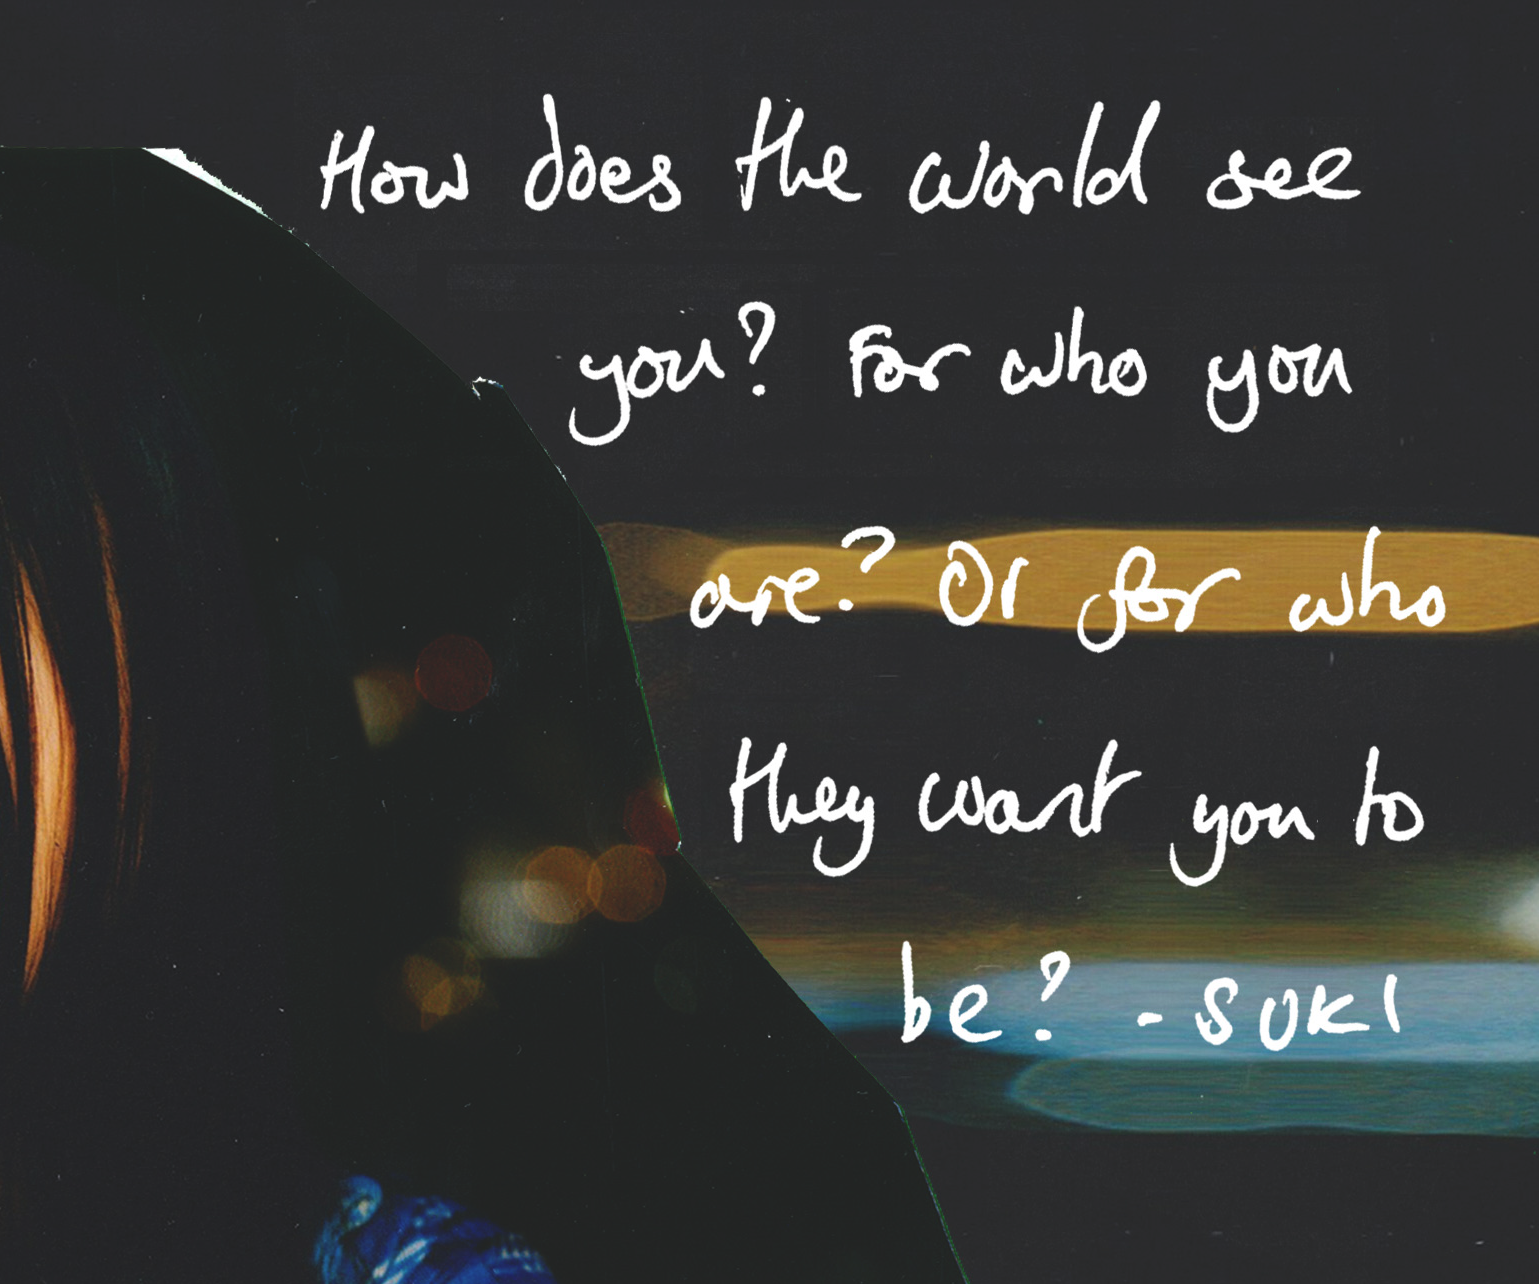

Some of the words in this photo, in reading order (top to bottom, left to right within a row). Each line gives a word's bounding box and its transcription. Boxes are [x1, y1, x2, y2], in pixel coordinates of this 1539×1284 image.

[320, 125, 469, 214] How
[524, 93, 682, 212] does
[735, 97, 862, 211] the
[908, 100, 1161, 215] world
[1206, 147, 1361, 210] see
[568, 301, 776, 446] you?
[1000, 306, 1148, 397] who
[1206, 343, 1353, 433] you
[690, 526, 896, 629] are?
[939, 540, 1029, 627] Or
[1077, 546, 1241, 653] for
[1289, 526, 1446, 632] who
[729, 737, 875, 877] they
[918, 739, 1142, 838] want
[1169, 794, 1315, 887] you
[1355, 746, 1424, 846] to
[901, 941, 1071, 1043] be?
